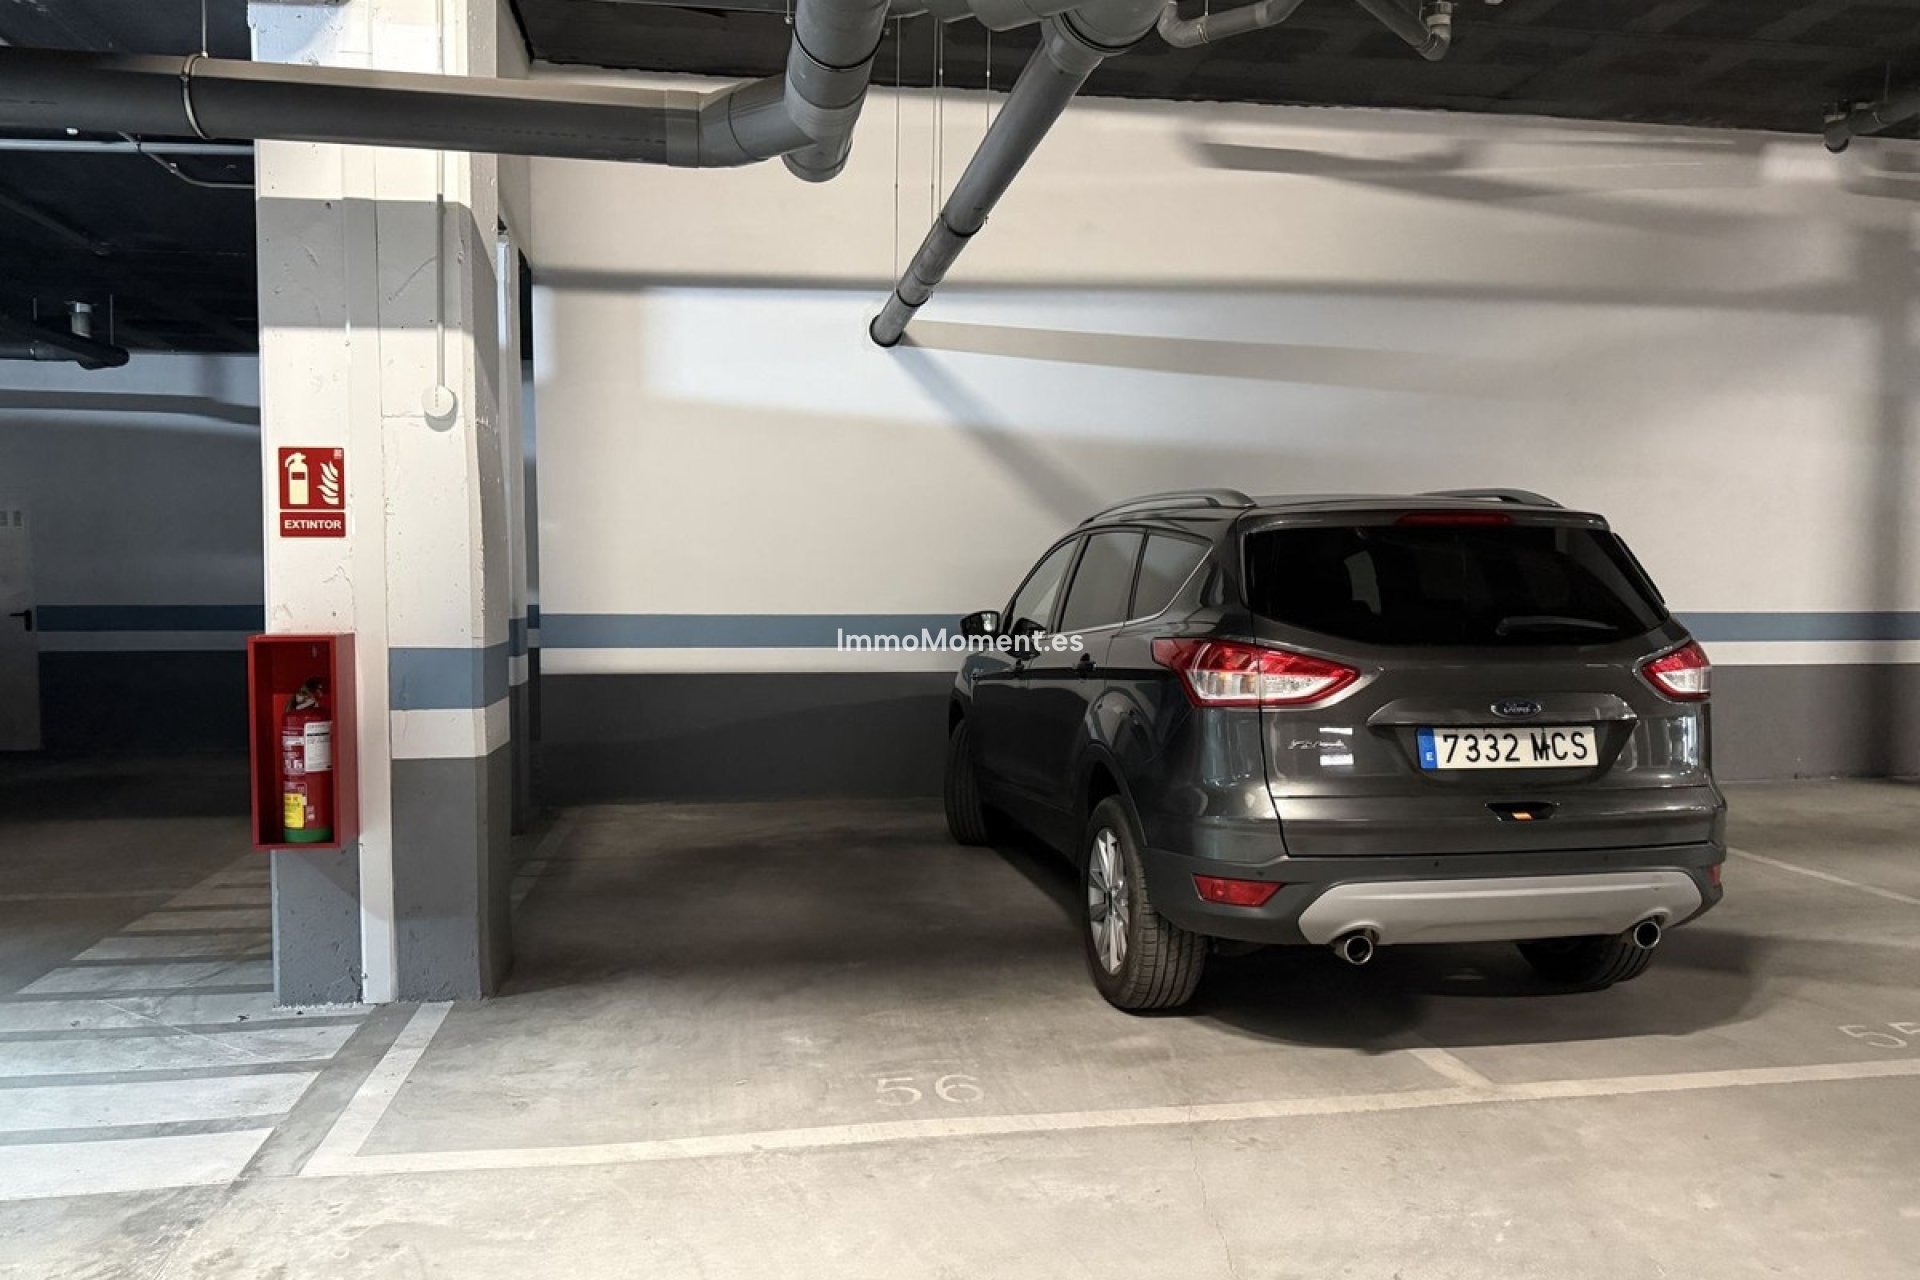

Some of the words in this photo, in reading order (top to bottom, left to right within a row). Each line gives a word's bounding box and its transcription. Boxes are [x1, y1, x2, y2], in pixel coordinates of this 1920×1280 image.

[284, 519, 342, 529] EXTINTOR
[1443, 734, 1520, 763] 7332
[1531, 731, 1588, 762] MCS
[876, 1074, 985, 1106] 56
